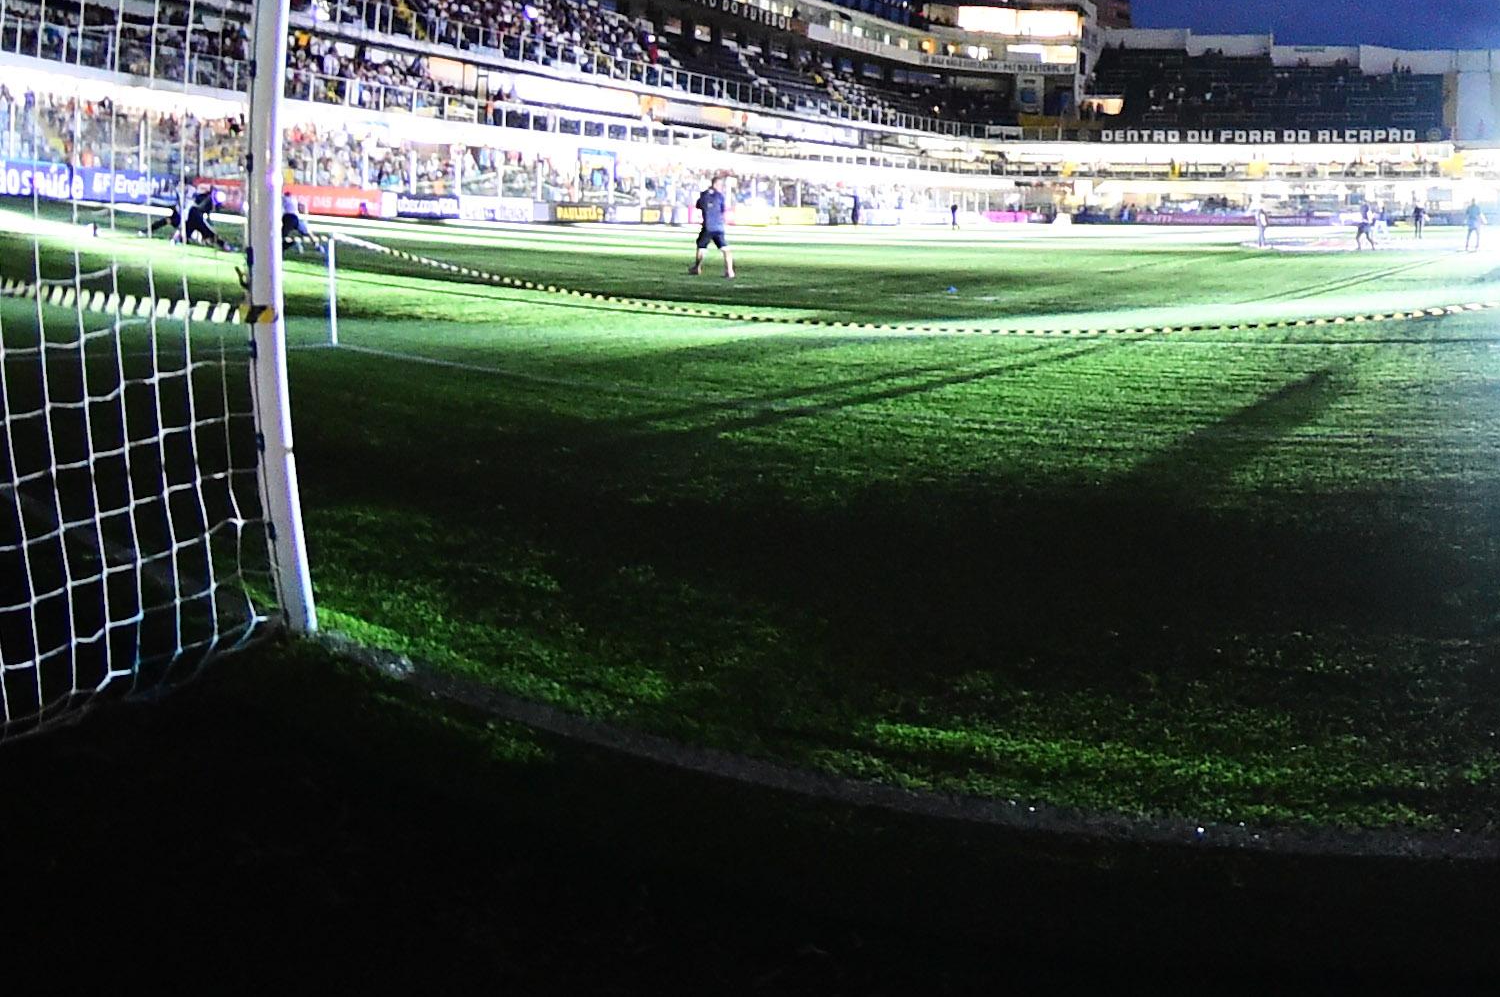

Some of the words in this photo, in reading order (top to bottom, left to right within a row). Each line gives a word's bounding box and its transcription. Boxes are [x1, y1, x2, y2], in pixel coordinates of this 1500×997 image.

[743, 5, 791, 31] FUTEBOL
[1101, 129, 1180, 142] DENTRO
[1187, 129, 1213, 142] OU
[1220, 129, 1276, 143] FORA
[1283, 129, 1311, 142] DO
